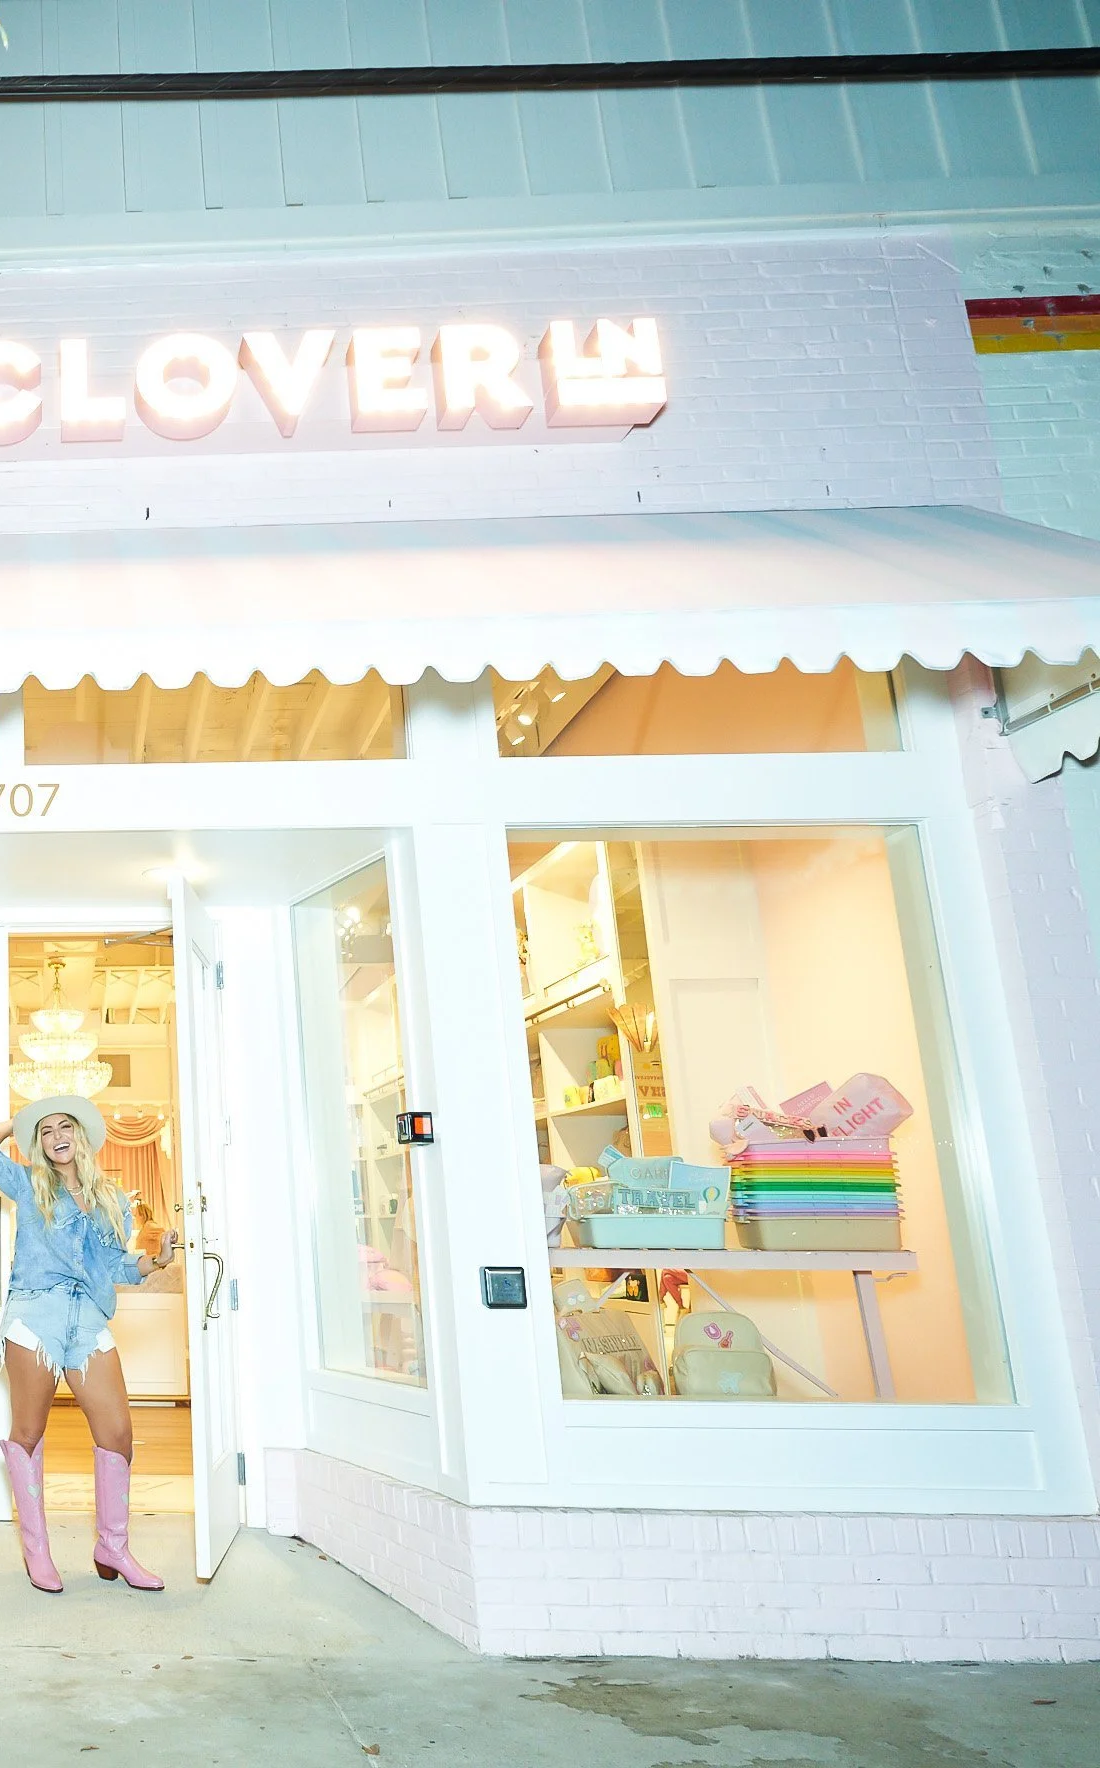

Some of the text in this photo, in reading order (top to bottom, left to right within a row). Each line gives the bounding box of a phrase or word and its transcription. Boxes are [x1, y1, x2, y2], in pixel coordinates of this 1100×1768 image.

[546, 316, 666, 380] LN
[832, 1096, 853, 1116] IN
[617, 1188, 697, 1210] TRAVEL
